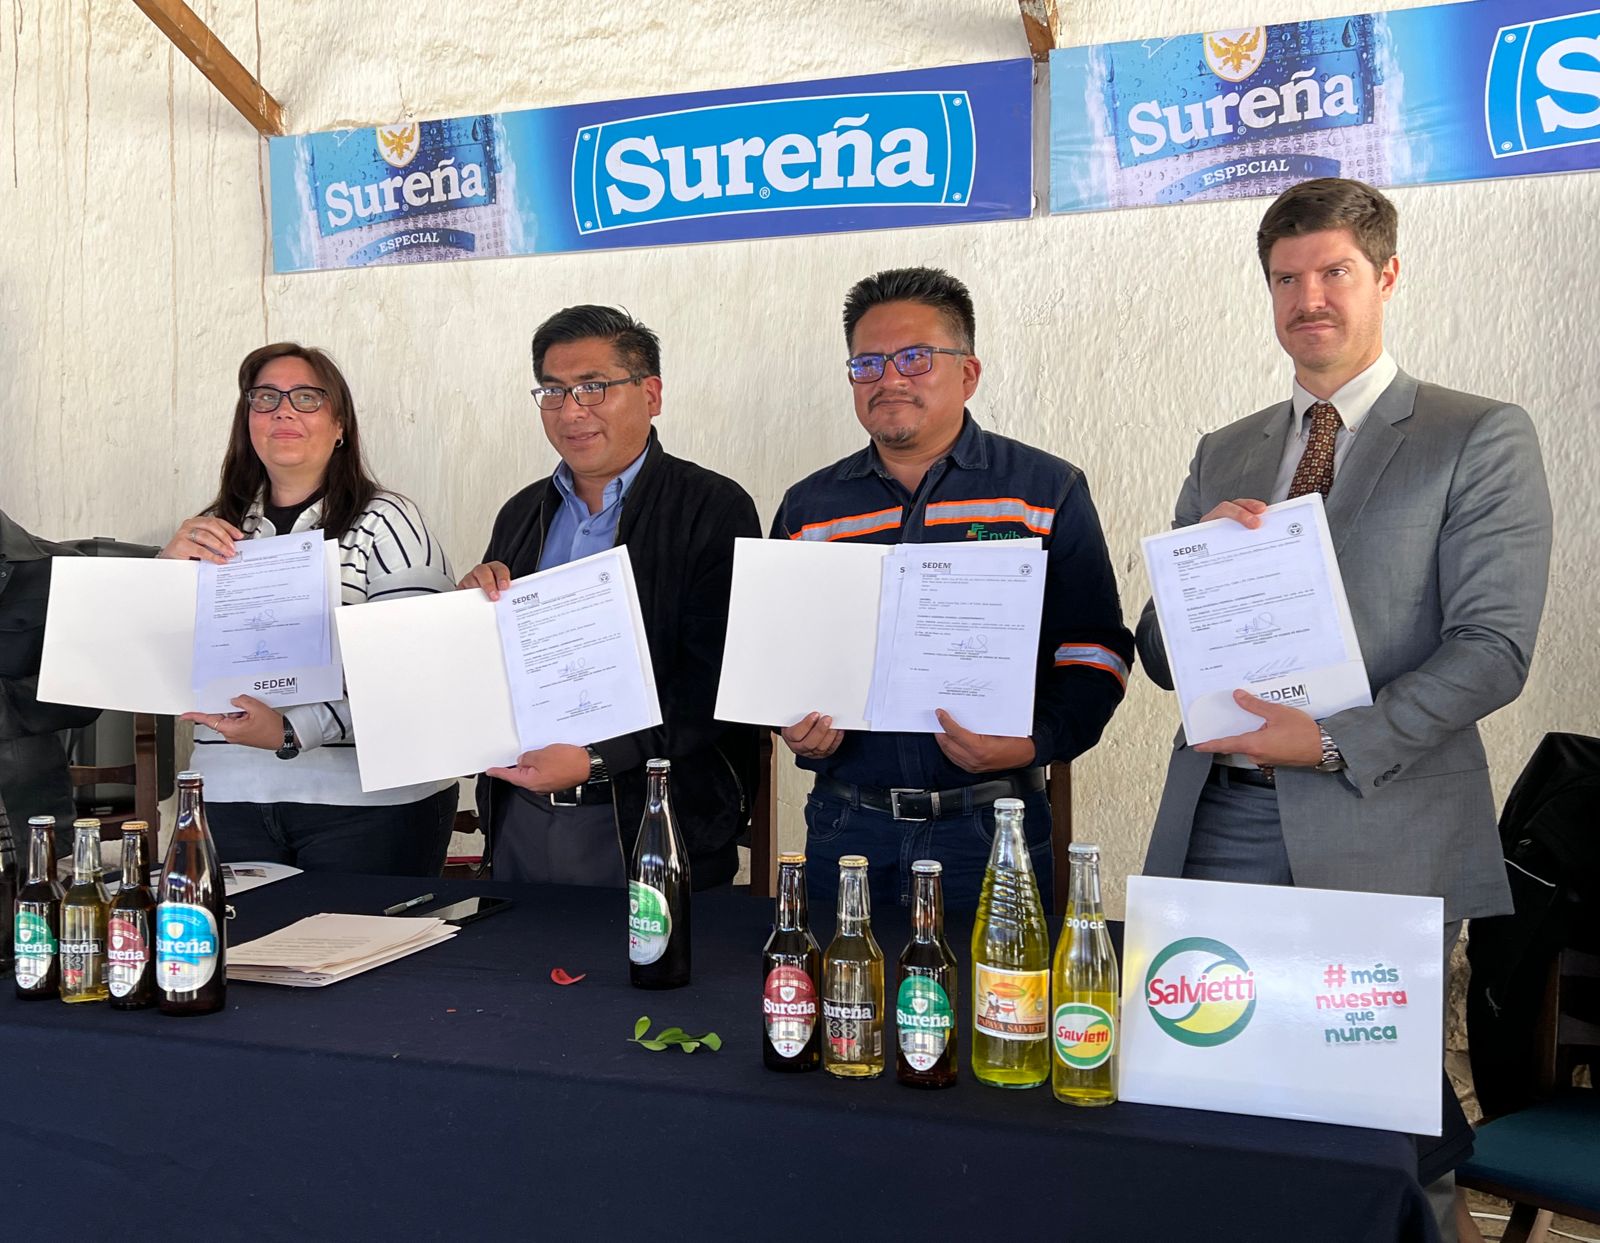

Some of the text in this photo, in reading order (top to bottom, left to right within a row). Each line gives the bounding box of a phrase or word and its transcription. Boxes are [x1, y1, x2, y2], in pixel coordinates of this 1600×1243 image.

[1127, 67, 1359, 157] Sureña
[605, 113, 935, 215] Sureña
[1202, 160, 1290, 186] ESPECIAL
[325, 158, 485, 228] Sureña
[379, 233, 441, 254] ESPECIAL
[1173, 543, 1207, 557] SEDEM
[922, 562, 951, 570] SEDEM
[512, 592, 539, 605] SEDEM
[254, 677, 296, 691] SEDEM
[1253, 683, 1304, 702] EDEM
[1148, 972, 1254, 1006] Salvietti
[764, 998, 817, 1016] Sureña
[1315, 989, 1407, 1011] nuestra
[897, 1009, 950, 1028] Sureña
[1345, 1009, 1375, 1026] que
[1325, 1025, 1398, 1044] nunca
